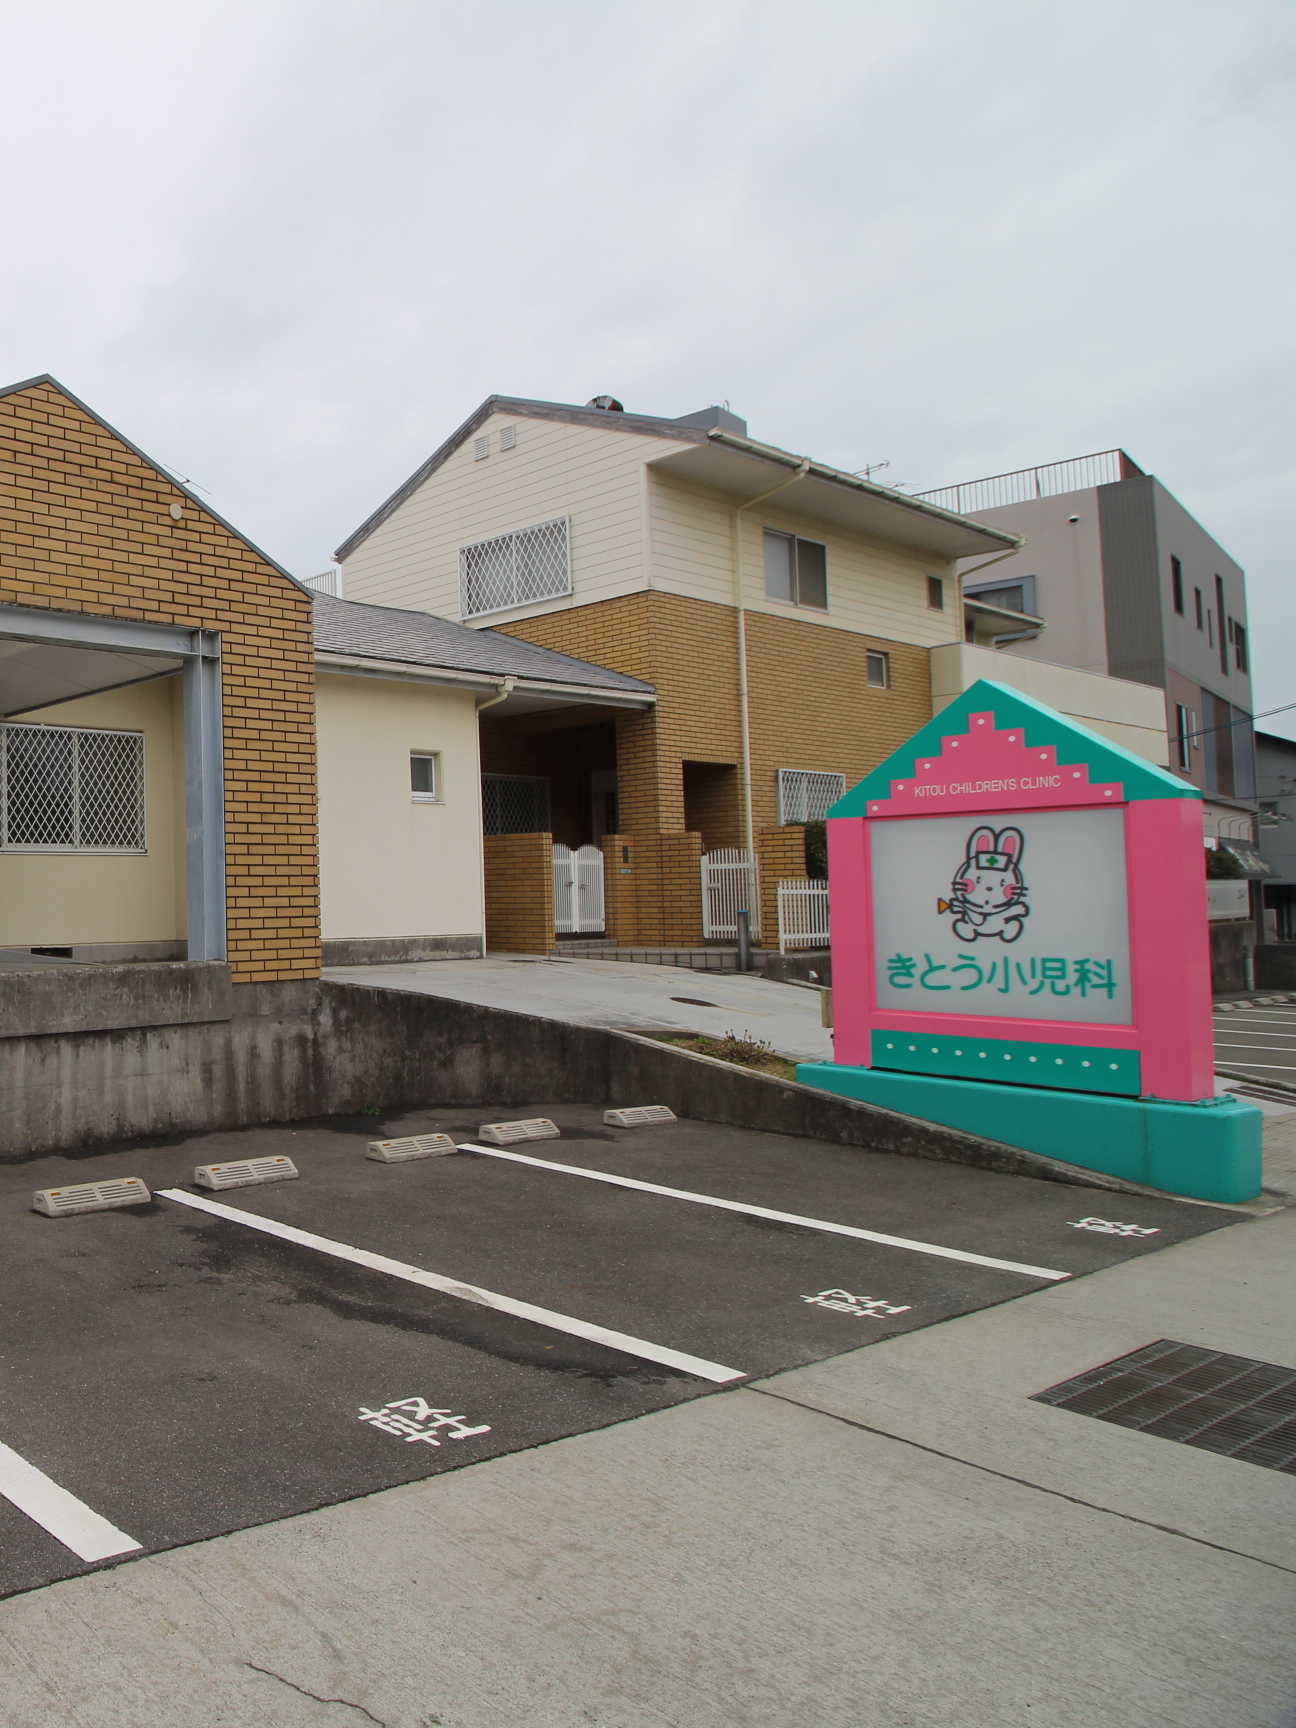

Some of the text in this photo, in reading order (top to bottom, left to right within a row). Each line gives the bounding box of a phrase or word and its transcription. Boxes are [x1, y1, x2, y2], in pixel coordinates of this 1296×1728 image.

[914, 775, 1061, 797] KITOU CHILDREN'S CLINIC
[887, 953, 1117, 1000] きとう小児科
[800, 1288, 913, 1319] 軽
[357, 1397, 491, 1446] 軽
